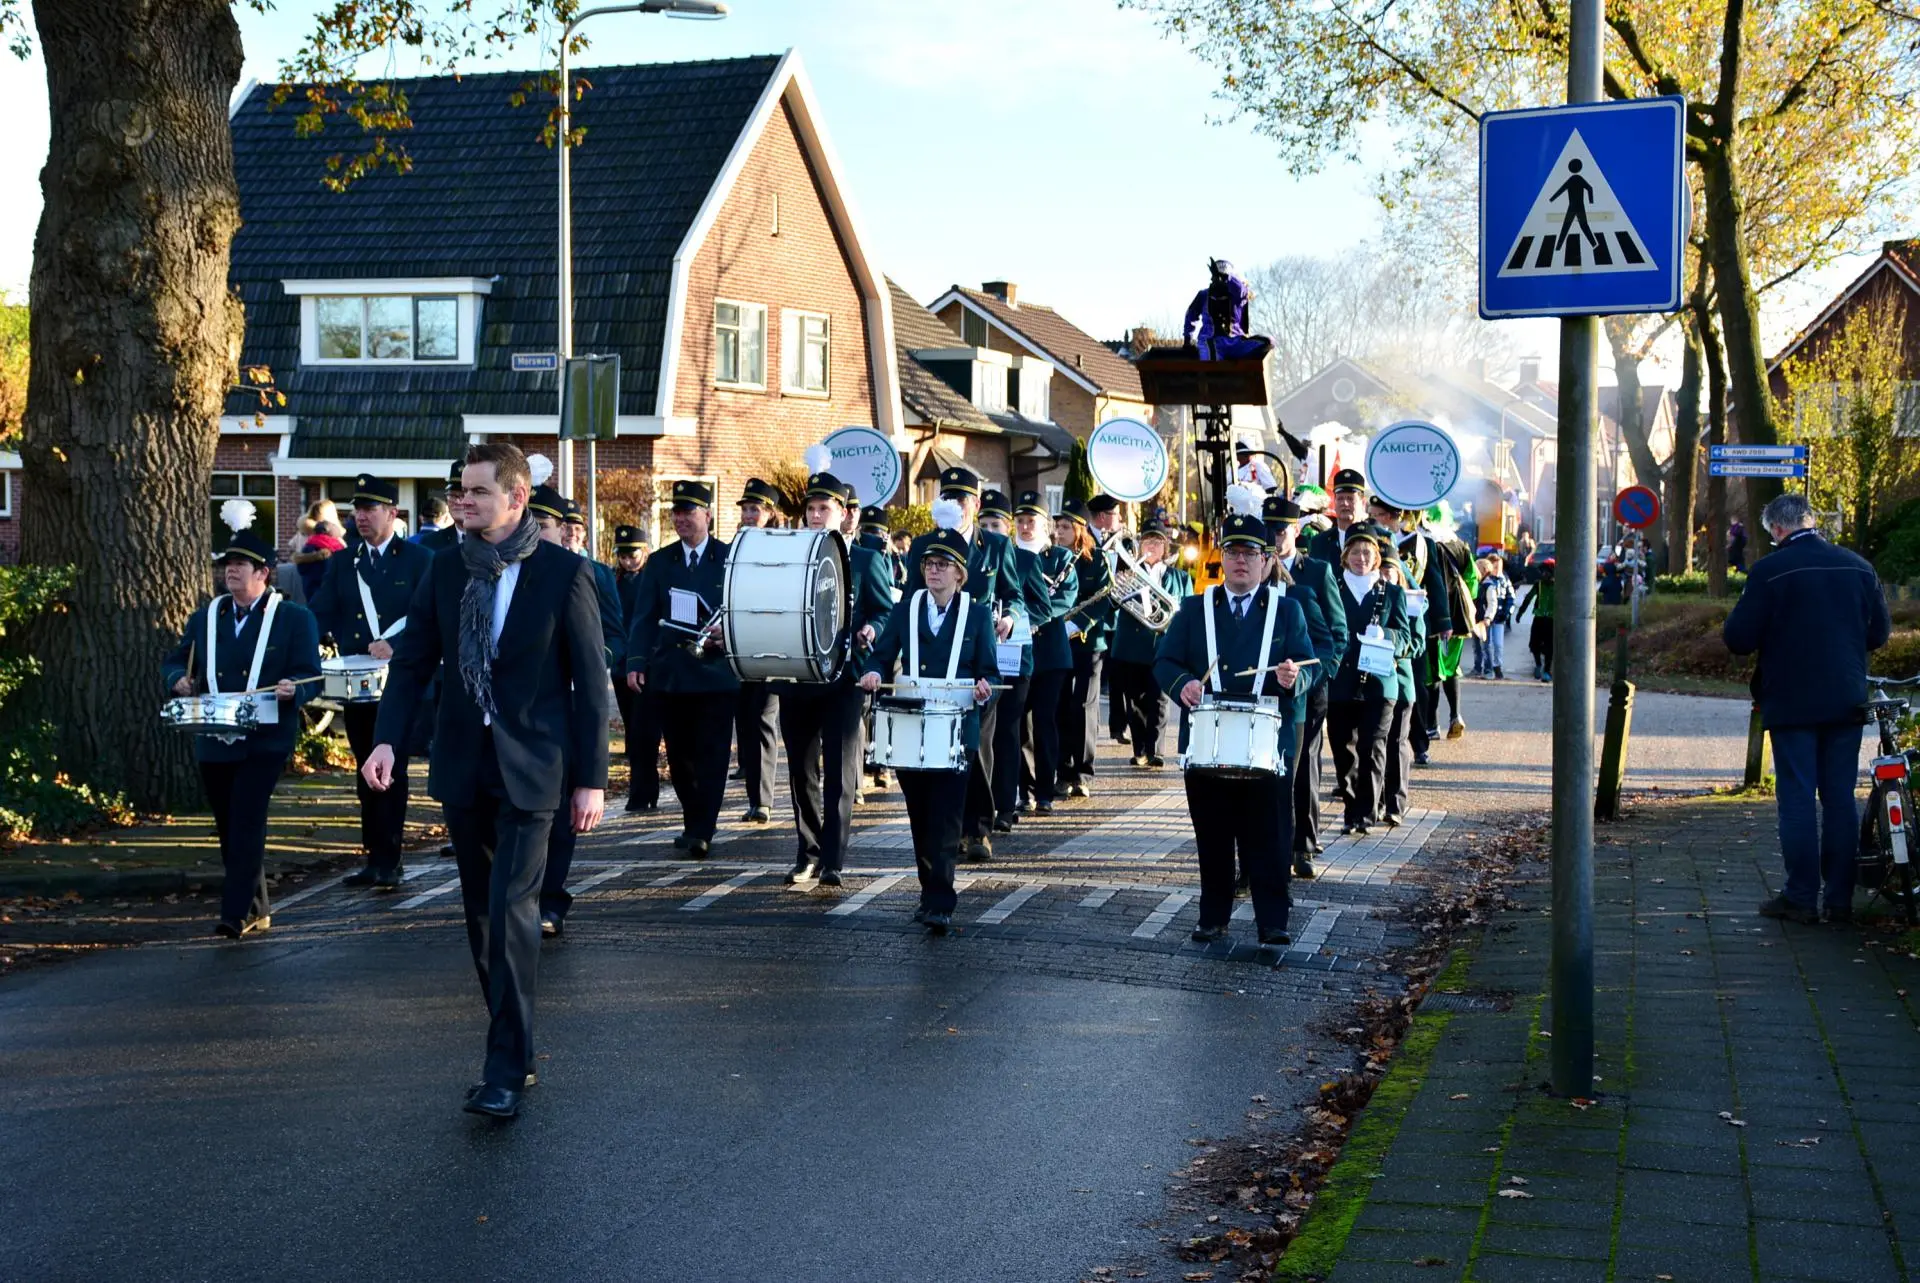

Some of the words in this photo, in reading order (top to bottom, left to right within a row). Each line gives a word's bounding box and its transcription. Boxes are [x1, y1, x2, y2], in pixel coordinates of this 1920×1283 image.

[1099, 434, 1152, 449] AMICITIA
[1380, 443, 1443, 453] AMICITIA
[830, 444, 882, 460] MICITIA
